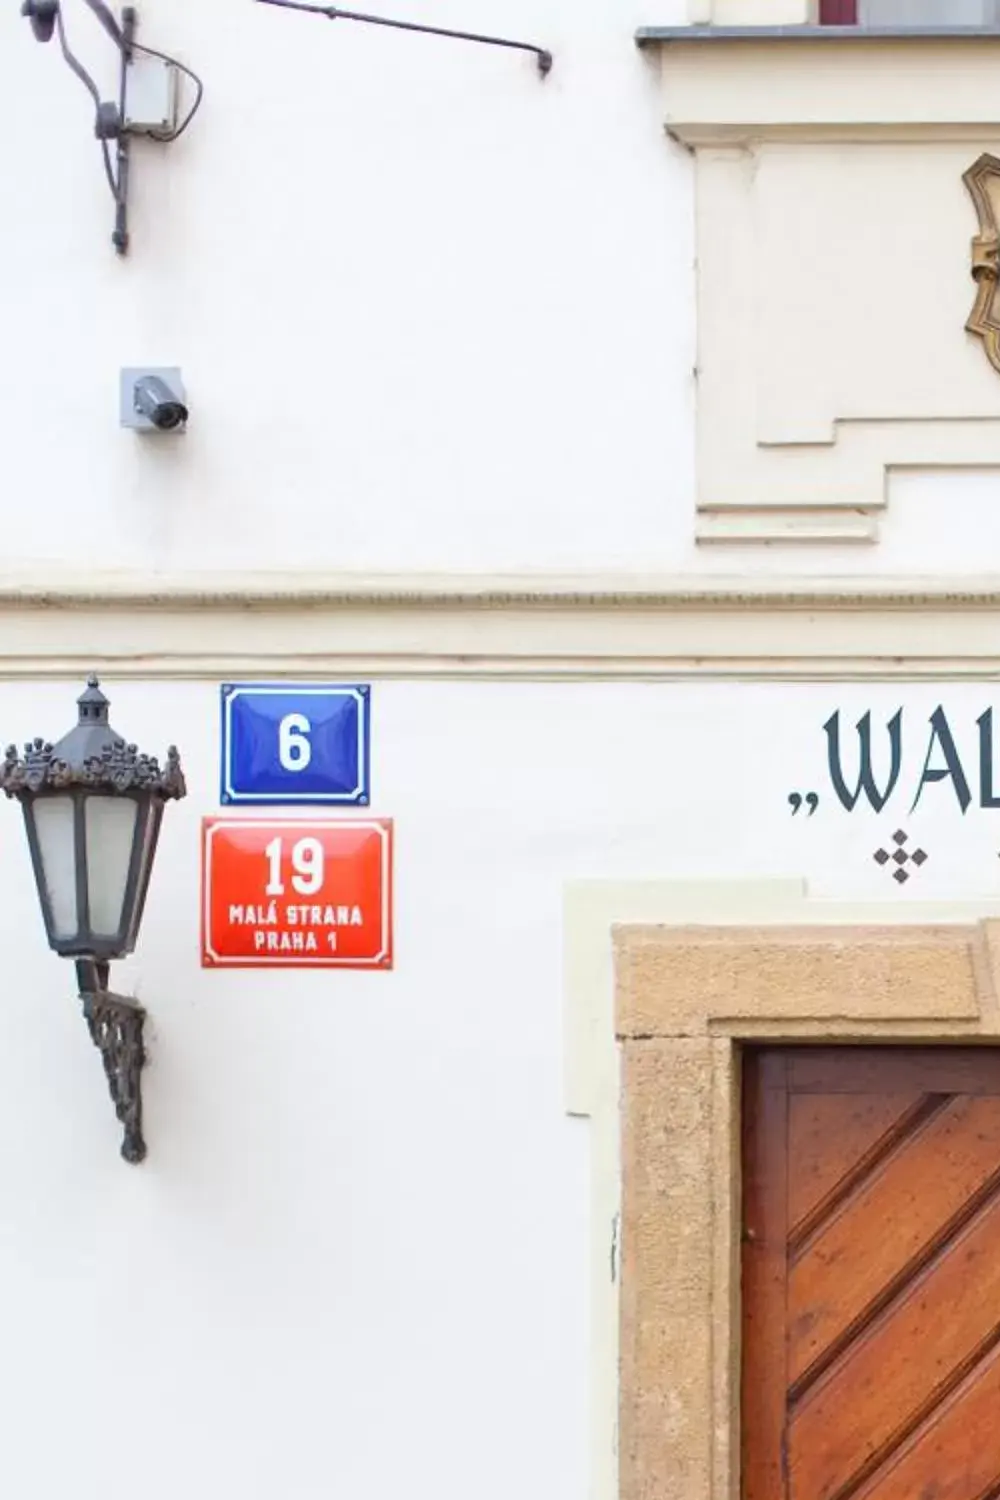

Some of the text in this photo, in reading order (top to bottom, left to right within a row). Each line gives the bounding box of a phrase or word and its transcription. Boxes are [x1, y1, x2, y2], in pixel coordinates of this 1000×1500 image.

[279, 713, 311, 772] 6
[264, 837, 324, 896] 19
[229, 900, 363, 925] MALÁ STRANA
[255, 931, 337, 951] PRAHA 1
